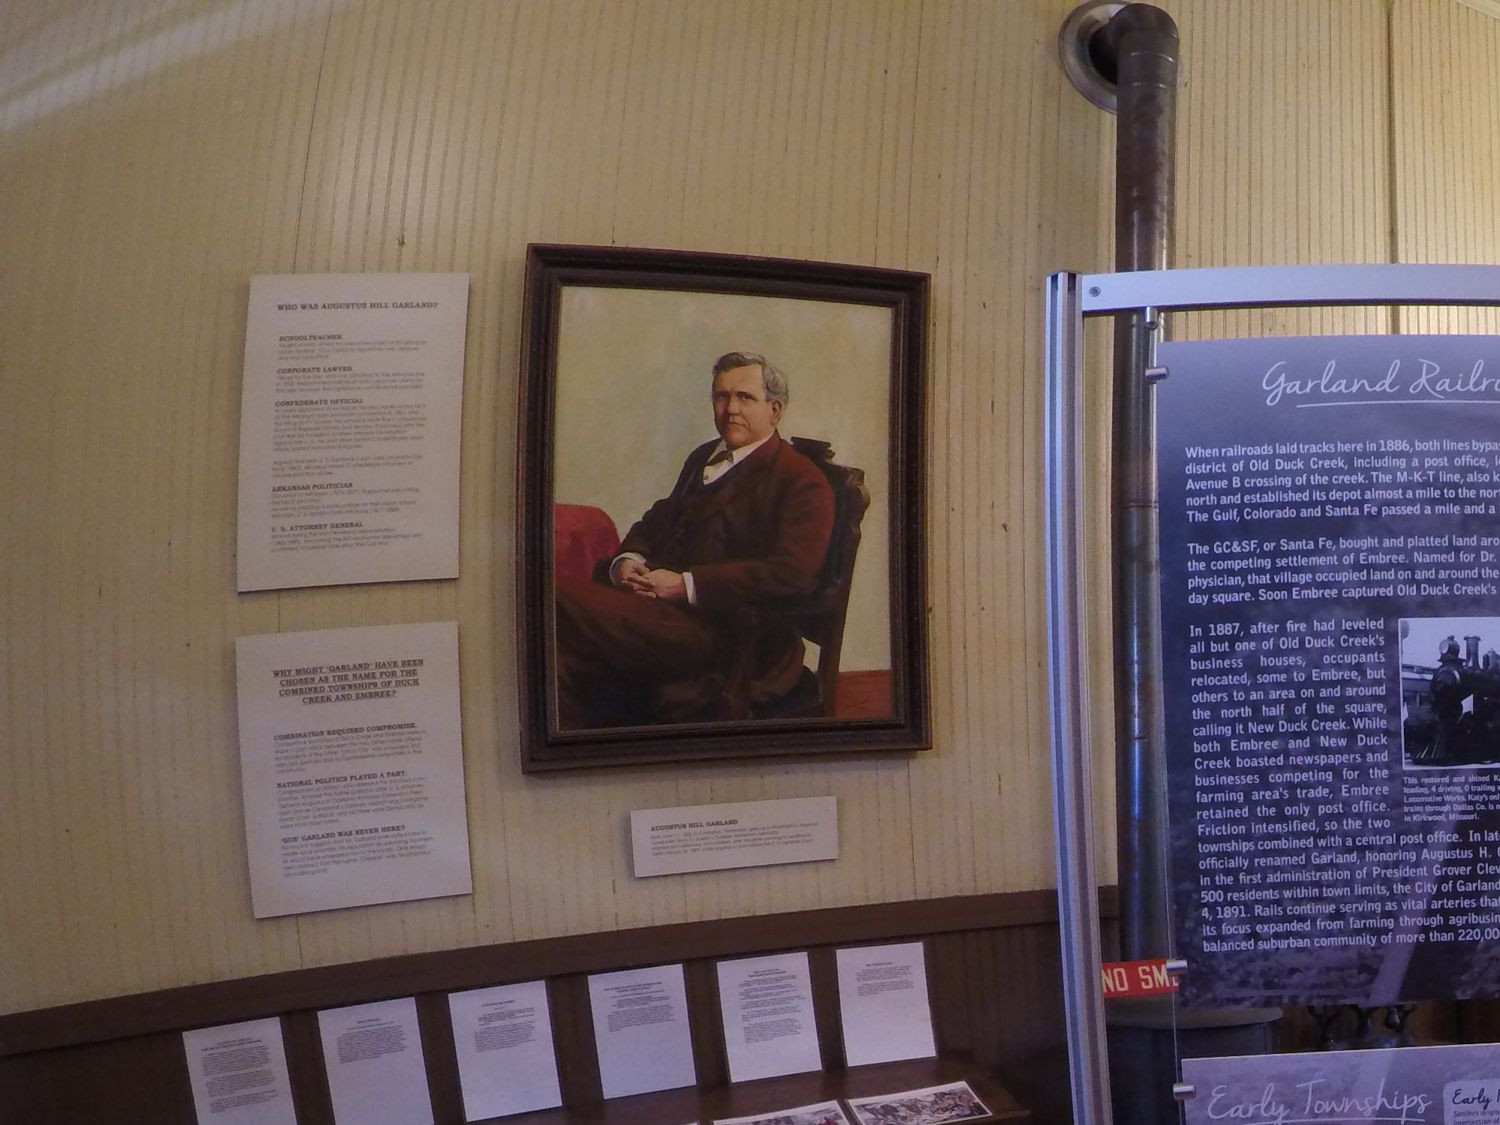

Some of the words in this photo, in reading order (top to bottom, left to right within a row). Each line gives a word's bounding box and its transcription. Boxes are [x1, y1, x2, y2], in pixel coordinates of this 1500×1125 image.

[1262, 359, 1401, 406] Garland
[1184, 445, 1219, 459] When
[1220, 442, 1274, 457] railroads
[1274, 441, 1298, 455] laid
[1298, 440, 1336, 454] tracks
[1336, 440, 1364, 453] here
[1365, 439, 1377, 452] in
[1378, 438, 1413, 454] 1886,
[1414, 438, 1441, 451] both
[1442, 438, 1470, 451] lines
[1189, 624, 1202, 637] In
[1208, 622, 1244, 637] 1887,
[1249, 620, 1280, 634] after
[1285, 619, 1307, 633] fire
[1312, 617, 1335, 631] had
[1339, 616, 1384, 631] leveled
[1202, 938, 1255, 952] balanced
[1257, 935, 1311, 949] suburban
[1313, 932, 1377, 948] community
[1381, 930, 1393, 943] of
[1396, 932, 1426, 943] more
[1428, 930, 1455, 943] than
[1101, 967, 1128, 993] NO
[1295, 1077, 1432, 1125] Townships
[1452, 1088, 1492, 1109] Early
